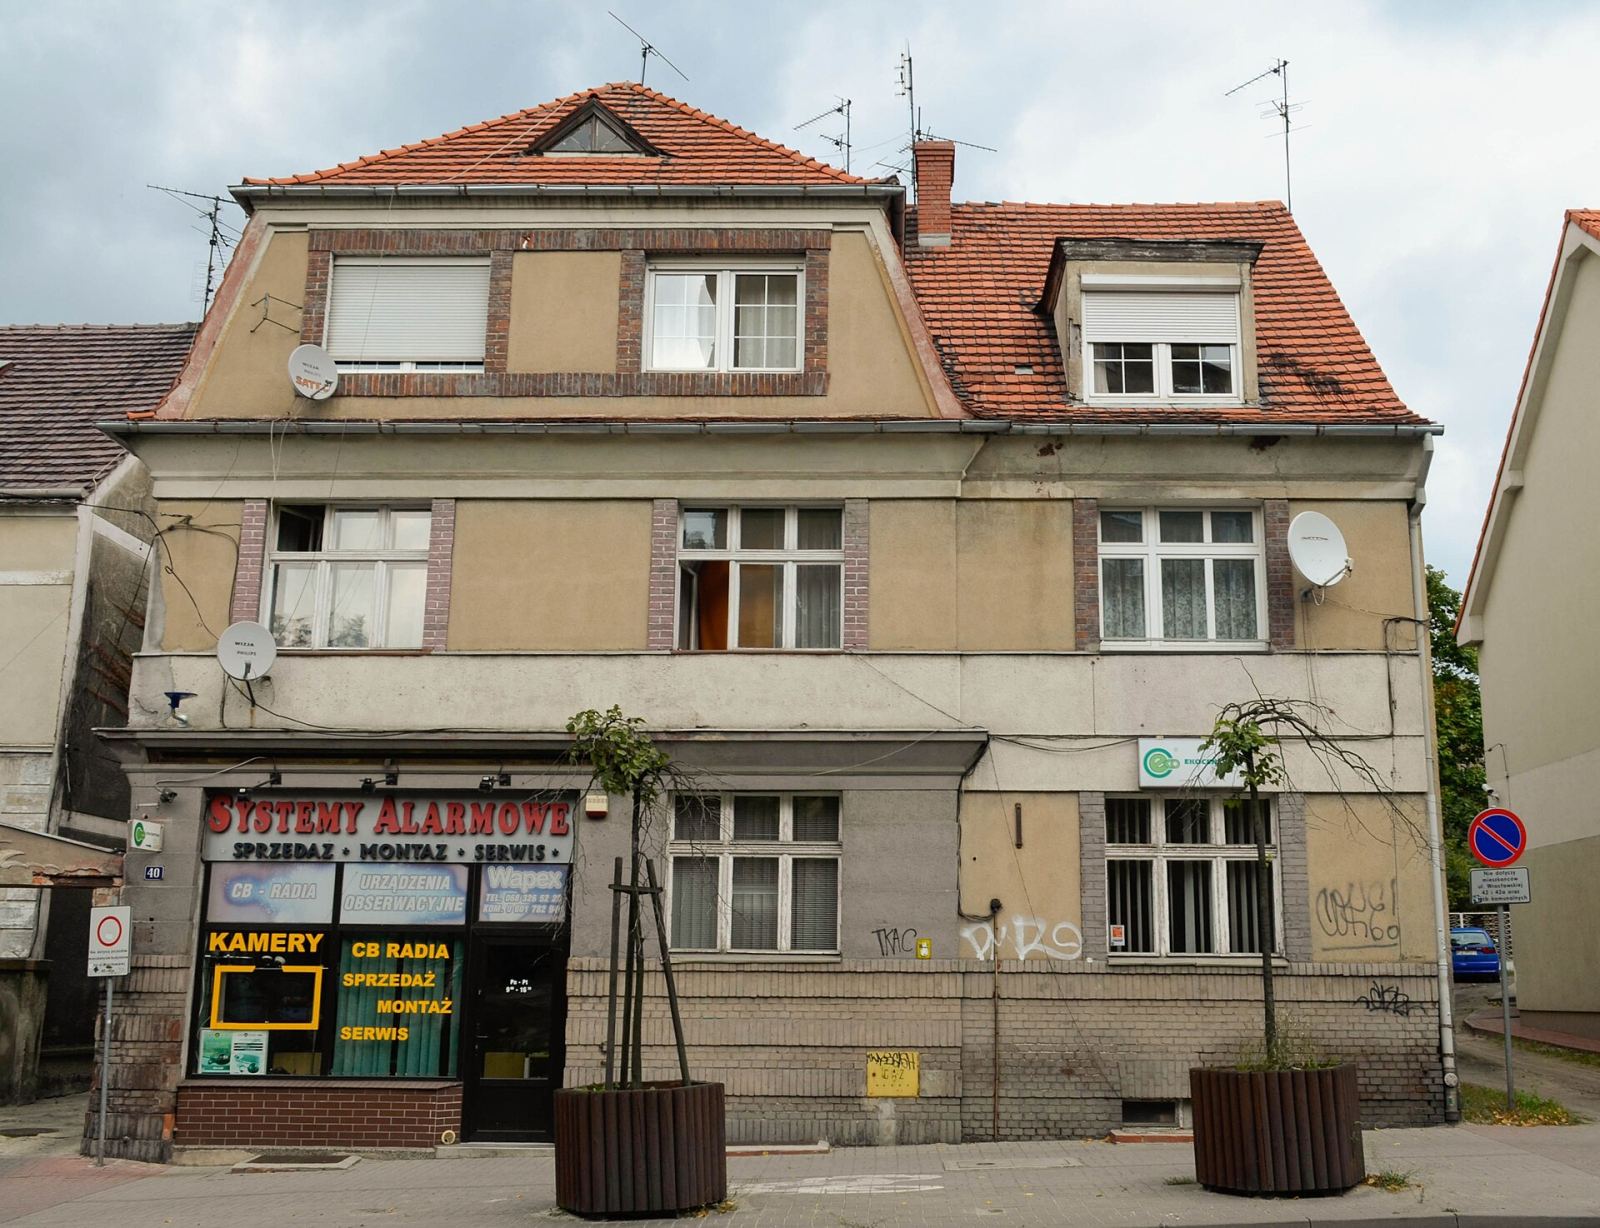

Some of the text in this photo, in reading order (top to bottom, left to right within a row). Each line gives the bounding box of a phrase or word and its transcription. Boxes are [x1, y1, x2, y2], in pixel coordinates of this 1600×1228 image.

[208, 793, 570, 836] SYSTEMY ALARMOWE
[474, 844, 546, 861] SERWIS
[147, 867, 160, 878] 40
[487, 865, 564, 894] Wapex
[231, 882, 253, 898] CB
[269, 882, 318, 899] RADIA
[360, 873, 451, 893] URZĄDZENIA
[343, 895, 464, 912] OBSERWACYJNE
[208, 932, 325, 953] KAMERY
[351, 942, 450, 959] CB RADIA
[871, 928, 917, 957] TKAC
[342, 970, 436, 988] SPRZEDAŻ
[376, 996, 453, 1014] MONTAŻ
[340, 1026, 409, 1041] SERWIS
